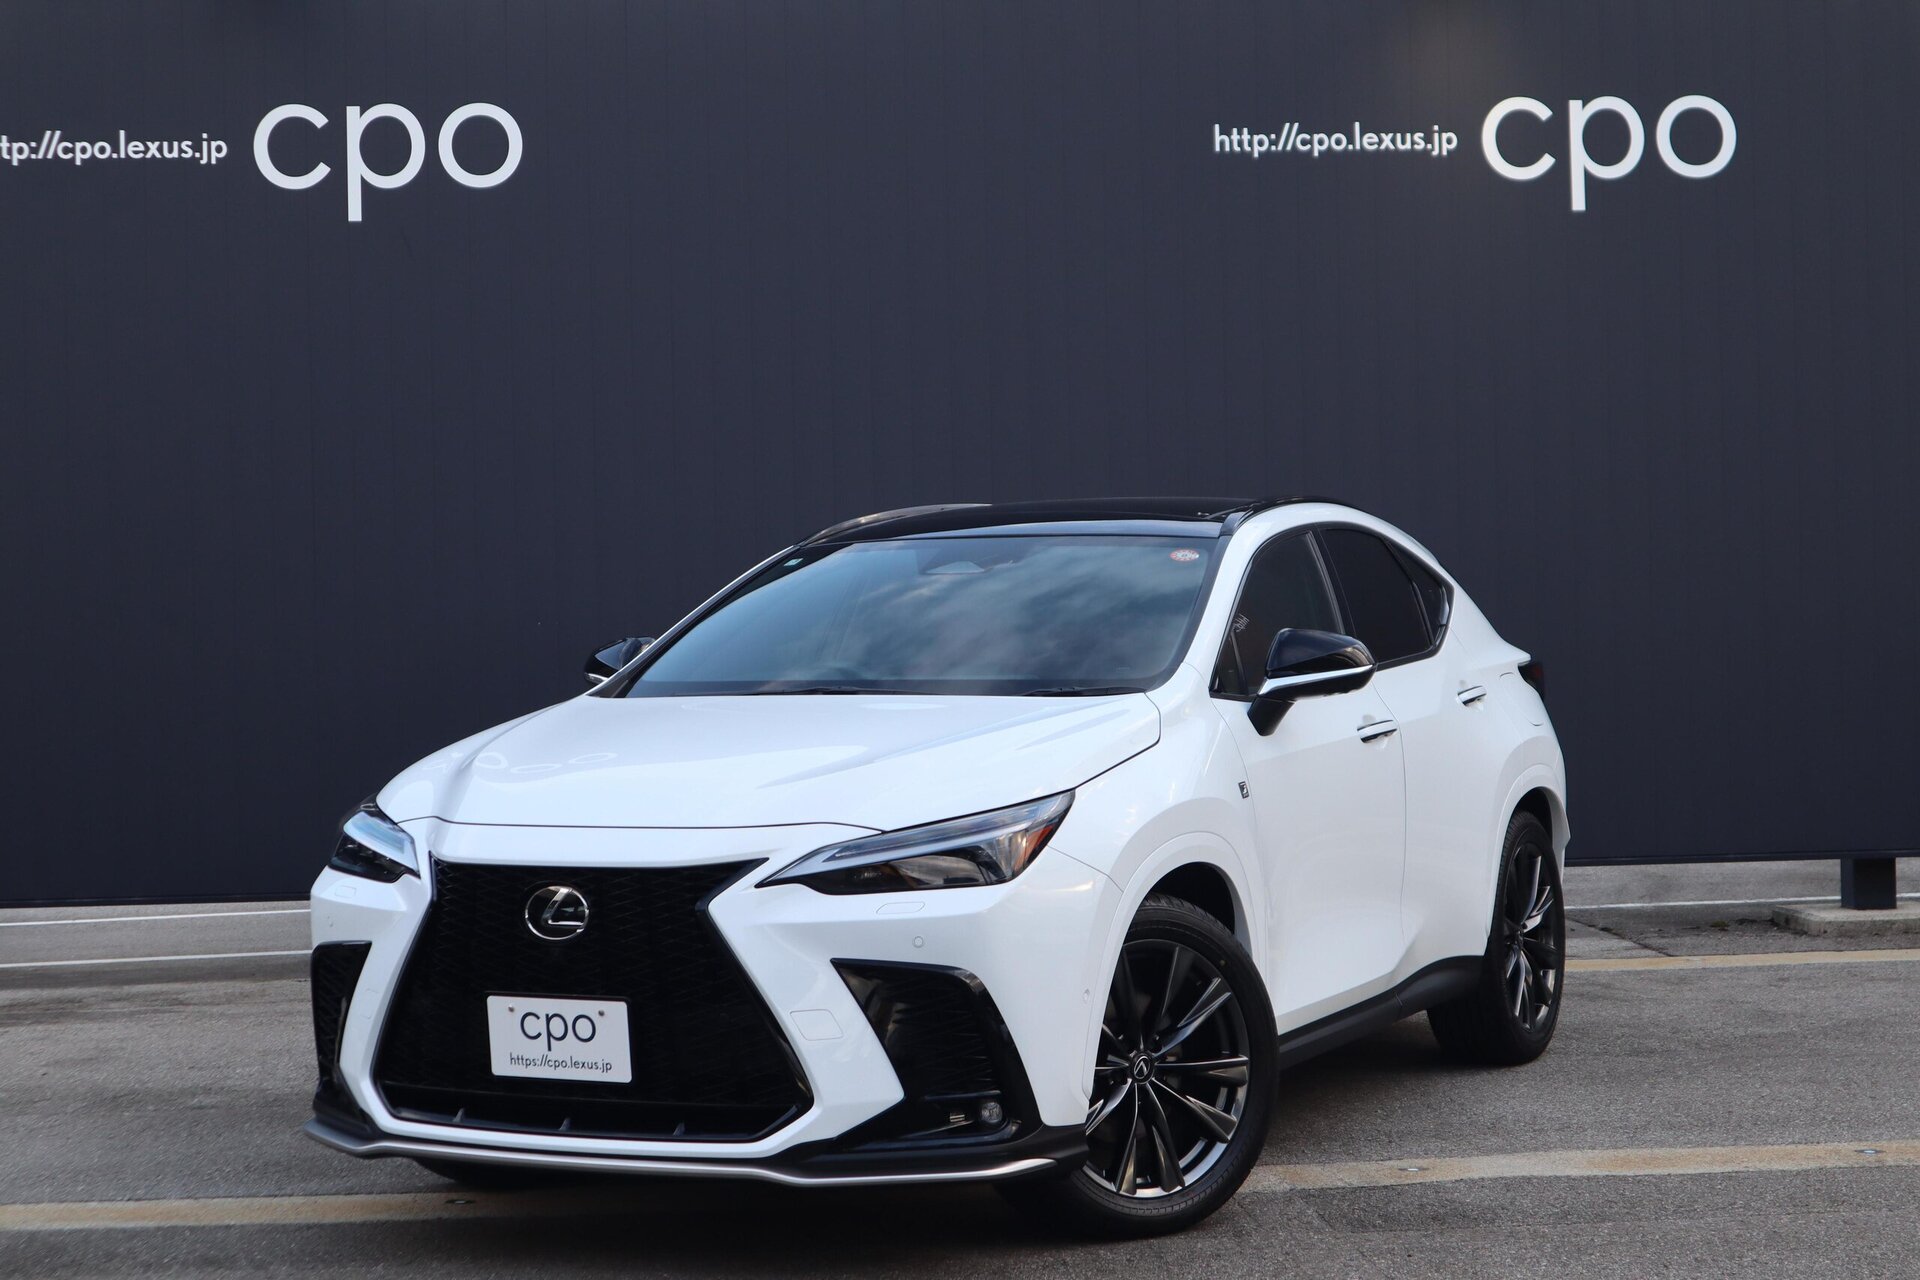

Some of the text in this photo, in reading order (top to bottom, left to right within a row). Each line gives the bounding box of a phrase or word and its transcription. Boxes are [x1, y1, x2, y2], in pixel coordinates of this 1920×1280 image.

[253, 102, 523, 222] cpo
[1214, 94, 1738, 212] http://cpo.lexus.jp cpo
[509, 1052, 613, 1073] https://cpo.lexus.jp
[520, 1011, 597, 1052] cpo
